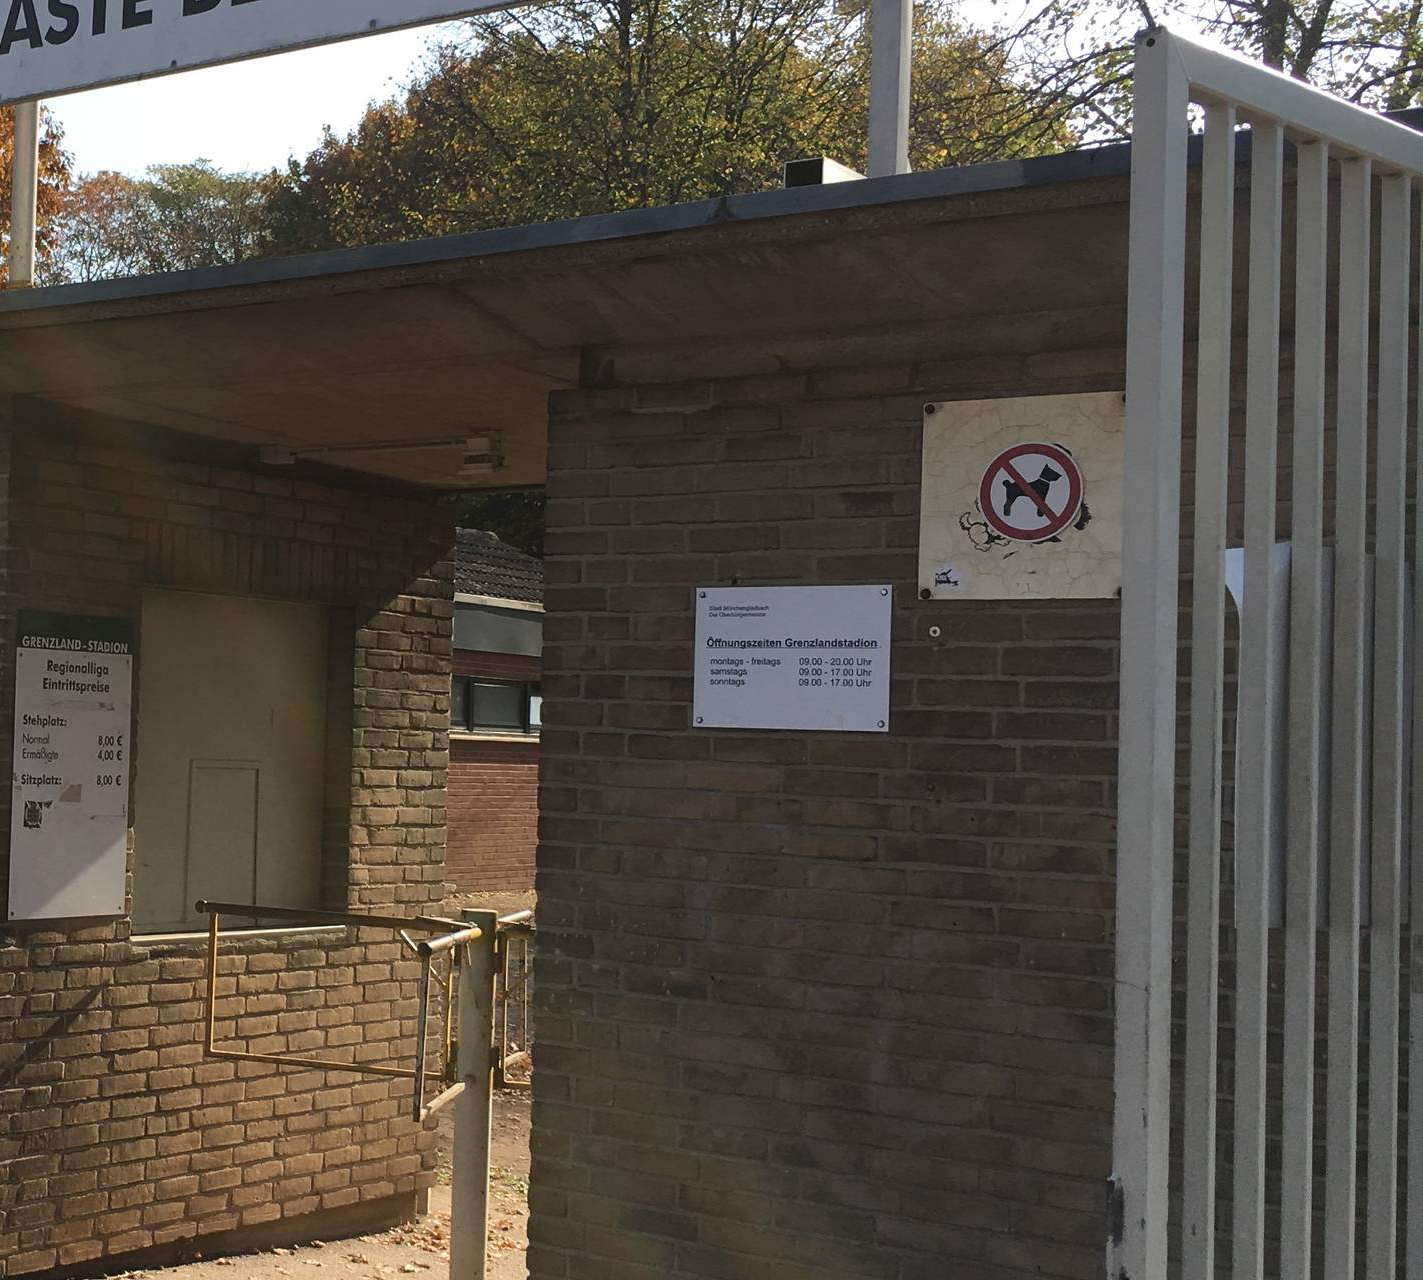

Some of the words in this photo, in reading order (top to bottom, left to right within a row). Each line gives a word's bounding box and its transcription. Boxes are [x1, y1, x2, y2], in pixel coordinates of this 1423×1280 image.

[706, 636, 782, 649] Öffnungszeiten
[784, 638, 878, 648] Grenzlandstadion
[710, 658, 744, 667] montags
[751, 657, 781, 666] freitags
[830, 658, 854, 666] 20.00
[856, 658, 872, 666] Uhr
[46, 660, 109, 678] Regionalliga
[710, 668, 748, 677] samstags
[830, 668, 854, 676] 17.00
[856, 668, 872, 677] Uhr
[42, 678, 110, 694] Eintrittspreise
[710, 678, 745, 687] sonntags
[799, 678, 822, 686] 09.00
[856, 679, 872, 687] Uhr
[23, 714, 67, 728] Stehplatz:
[22, 733, 50, 744] Normal
[98, 735, 114, 747] 8,00
[117, 736, 123, 746] €
[22, 747, 58, 762] Ermäßigte
[97, 750, 114, 762] 4,00
[116, 750, 122, 760] €
[21, 774, 62, 787] Sitzplatz:
[96, 775, 112, 787] 8,00
[116, 775, 121, 786] €
